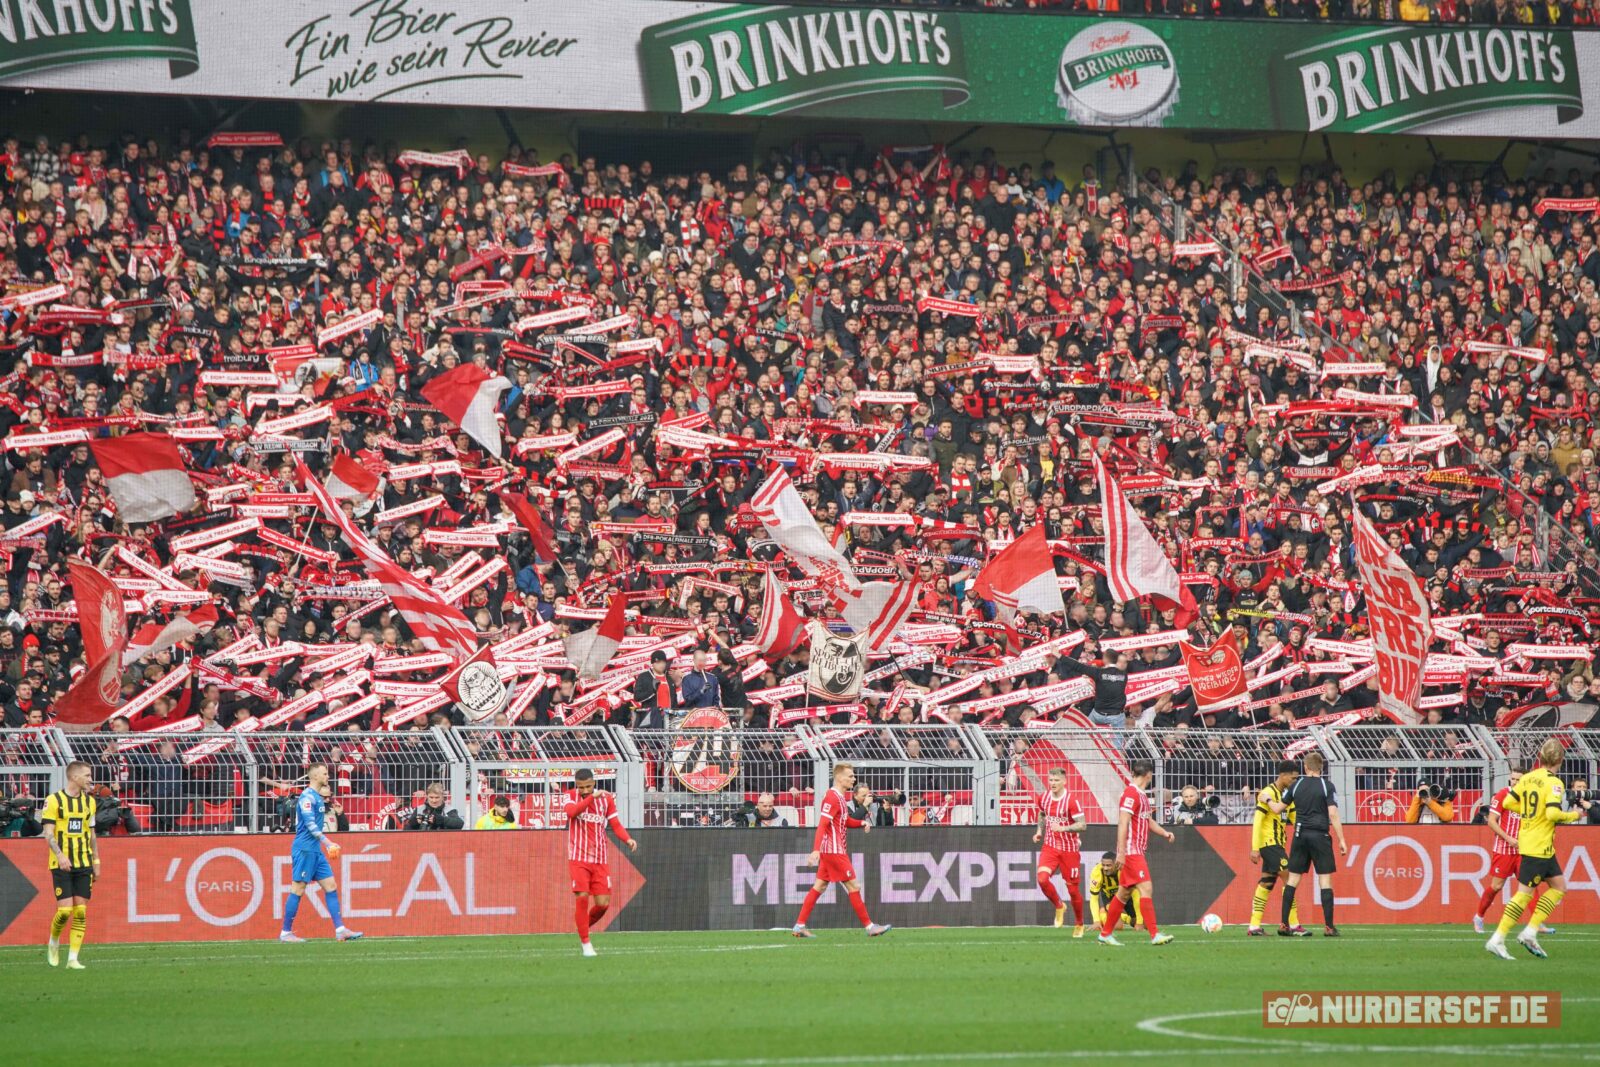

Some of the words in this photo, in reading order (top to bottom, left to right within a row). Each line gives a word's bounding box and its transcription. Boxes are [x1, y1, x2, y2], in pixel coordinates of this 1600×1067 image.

[285, 14, 350, 87] Ein
[350, 0, 457, 47] Bier
[327, 59, 377, 98] wie
[386, 42, 449, 76] sein
[453, 17, 578, 68] Revier
[1215, 666, 1239, 680] WIEDER
[1197, 675, 1237, 692] FREIBURG
[1521, 790, 1539, 818] 19
[69, 819, 81, 830] 1&1
[1070, 867, 1079, 879] 17
